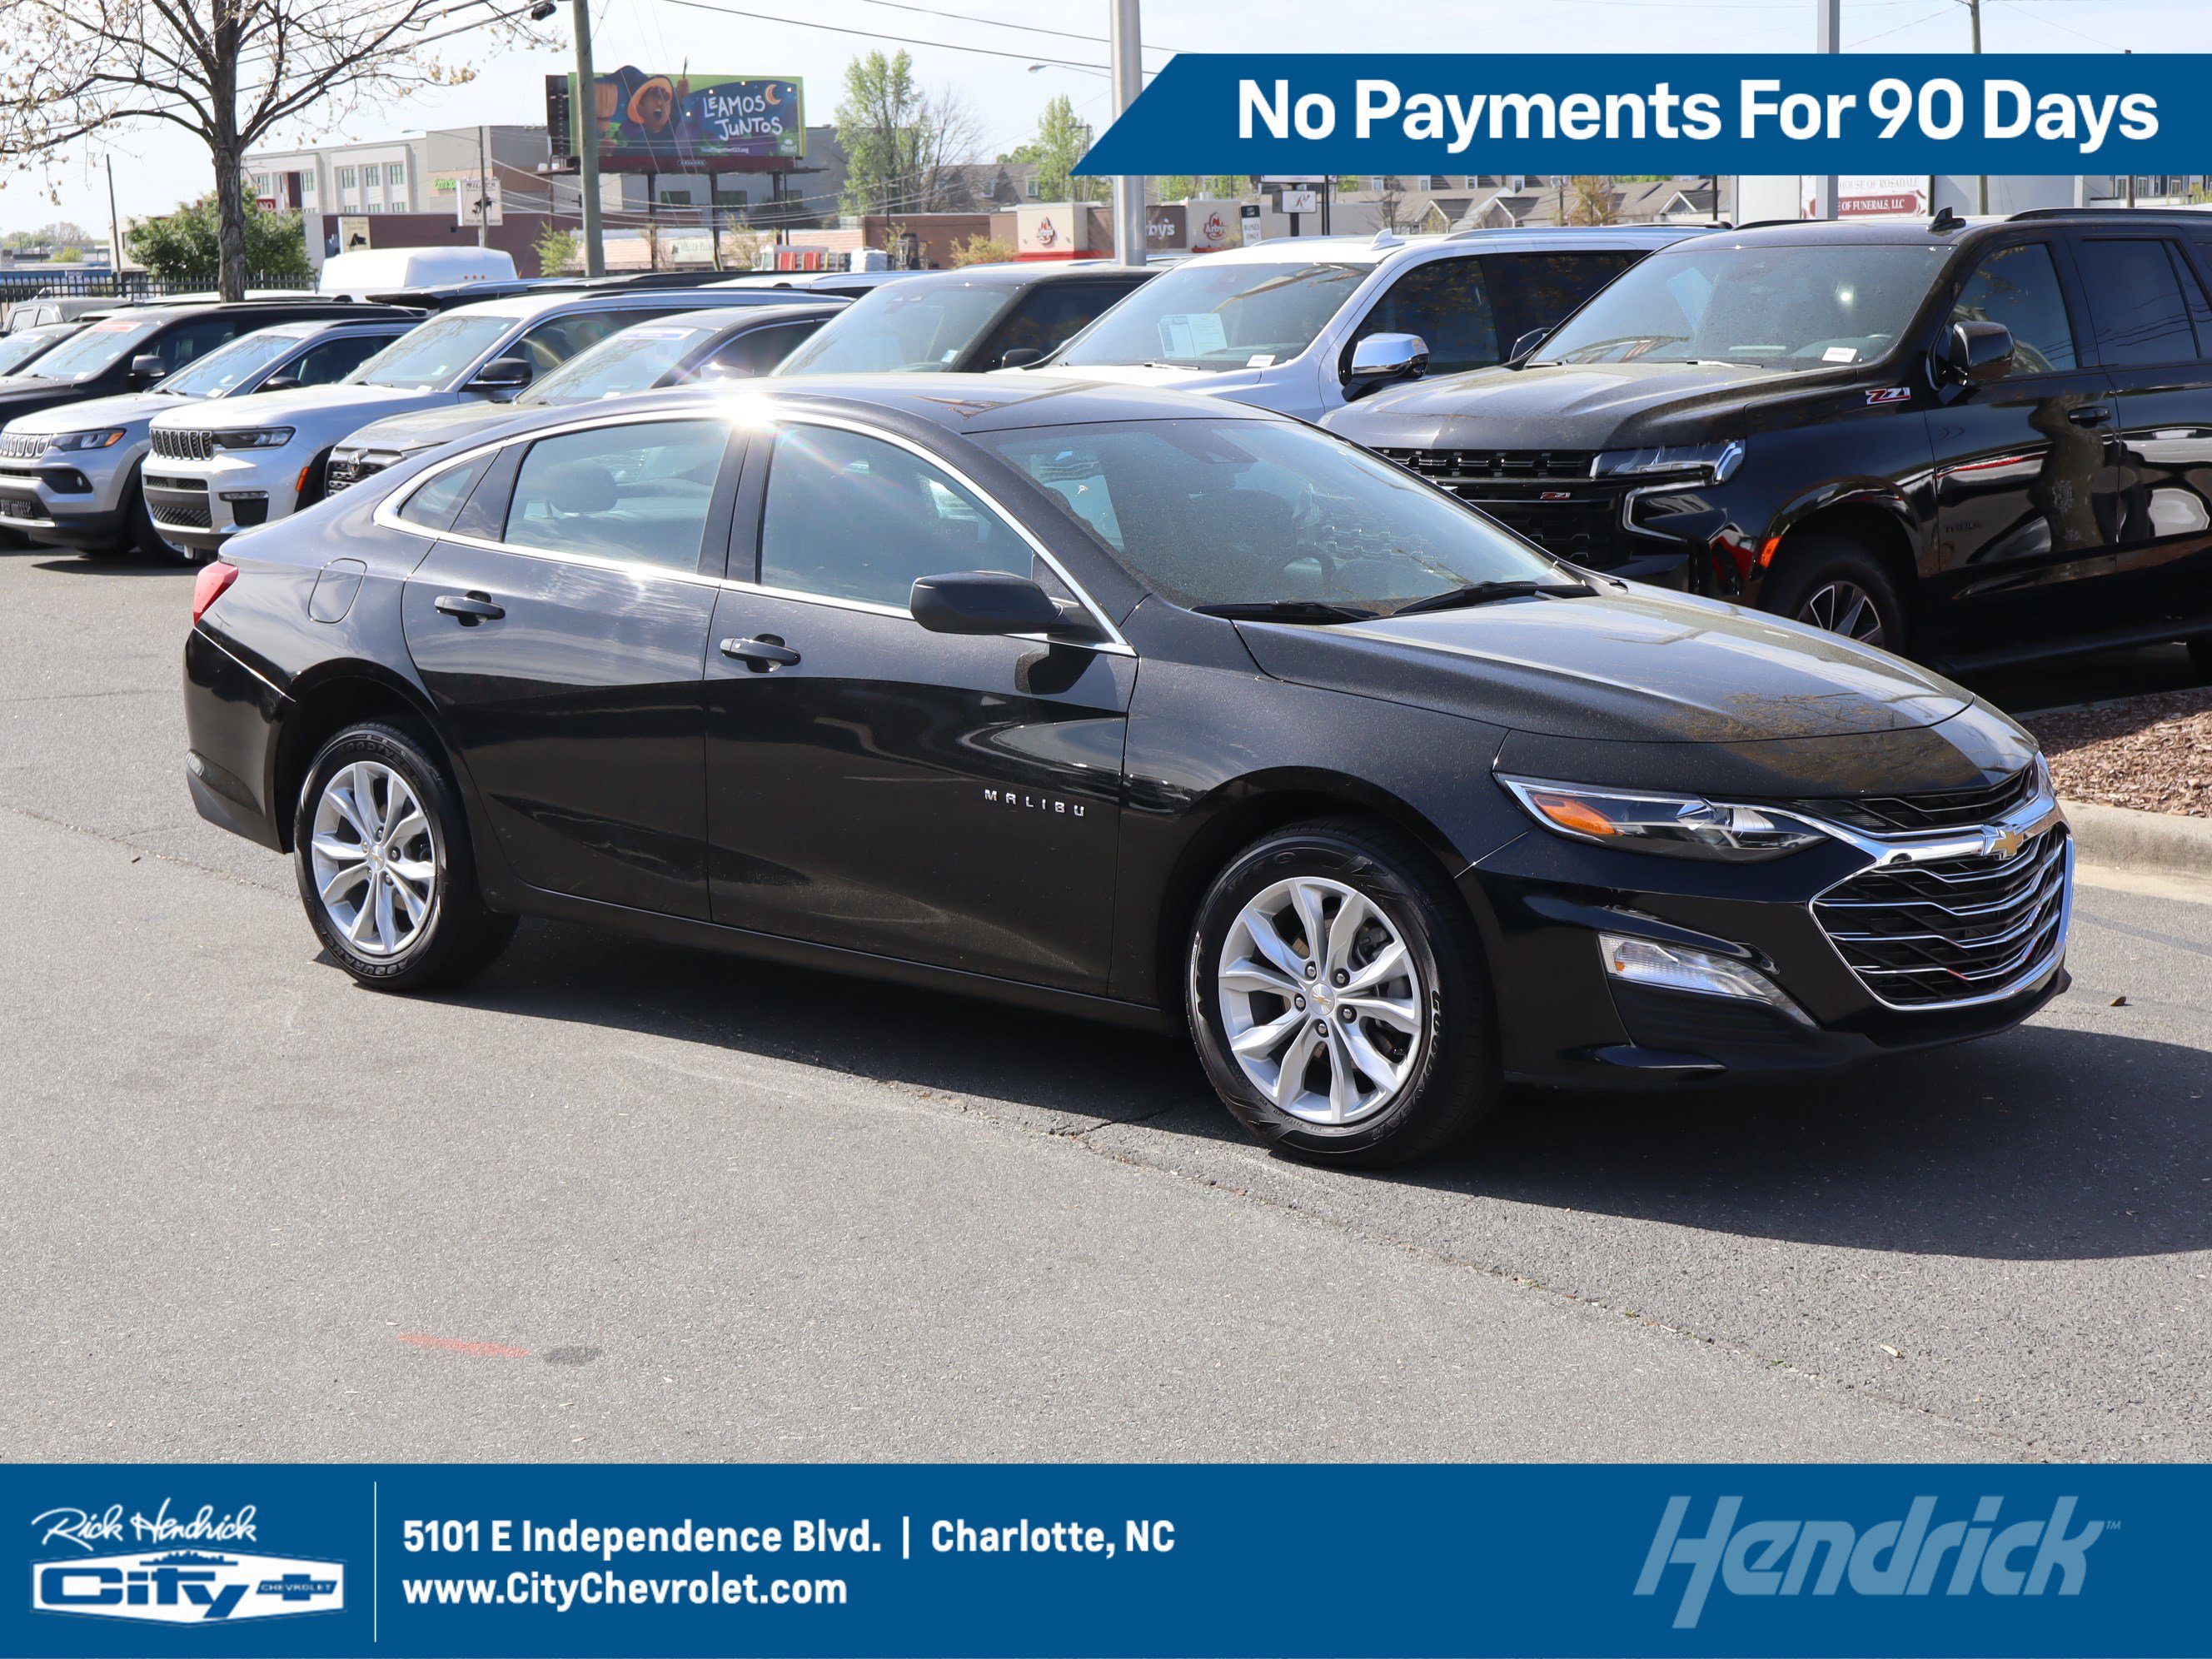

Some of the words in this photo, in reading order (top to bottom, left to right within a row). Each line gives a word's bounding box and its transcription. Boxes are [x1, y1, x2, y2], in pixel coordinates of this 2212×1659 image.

[703, 95, 765, 117] LEAMOS
[715, 117, 783, 141] JUNTOS
[1840, 180, 1866, 191] HOUSE
[1866, 180, 1878, 189] OF
[1880, 177, 1920, 189] ROSADALE
[1841, 201, 1852, 211] OF
[1891, 199, 1905, 209] LLC
[1866, 387, 1911, 406] Z71
[984, 789, 1084, 817] MALIBU
